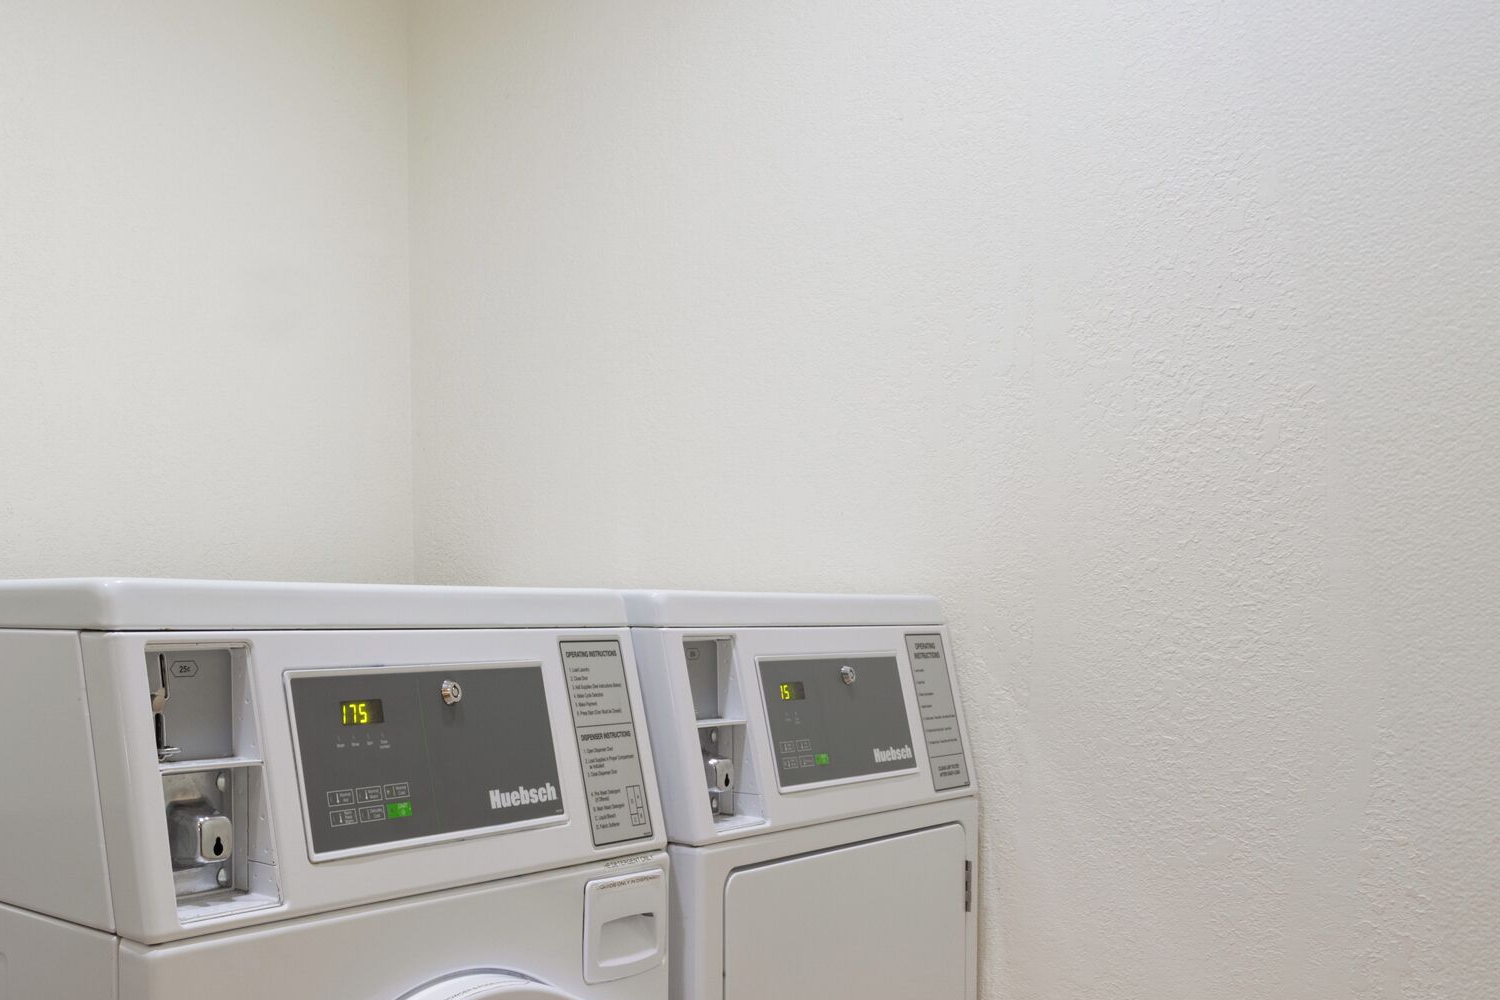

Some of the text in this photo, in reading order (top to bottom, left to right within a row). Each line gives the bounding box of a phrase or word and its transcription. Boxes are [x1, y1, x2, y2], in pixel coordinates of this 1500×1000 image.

[565, 650, 588, 658] OPERATING
[780, 684, 790, 700] 15
[342, 703, 368, 724] 175
[580, 730, 631, 741] DISPENSER INSTRUCTIONS
[873, 744, 913, 763] Huebsch
[489, 782, 557, 809] Huebsch
